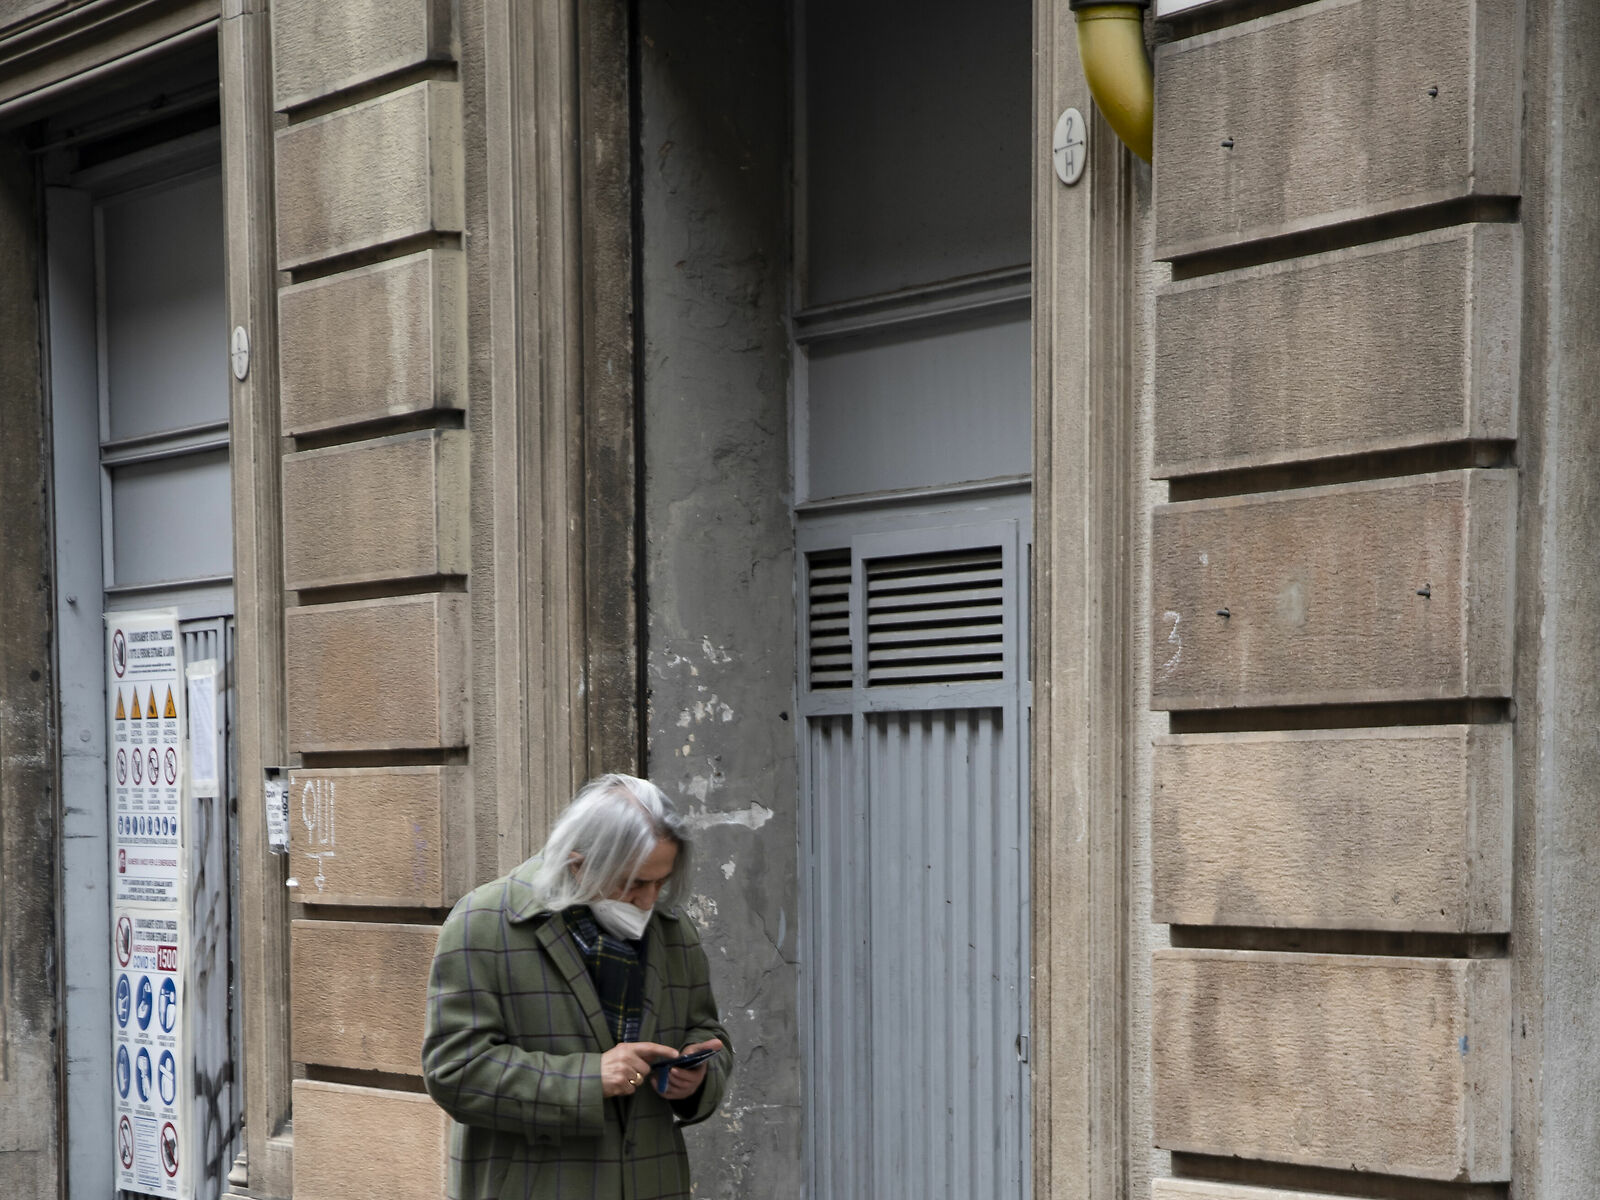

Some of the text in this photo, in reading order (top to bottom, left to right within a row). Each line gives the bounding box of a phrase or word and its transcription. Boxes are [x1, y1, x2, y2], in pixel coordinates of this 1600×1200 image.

[1065, 116, 1073, 143] 2
[1065, 149, 1074, 177] H
[157, 949, 177, 969] 1500
